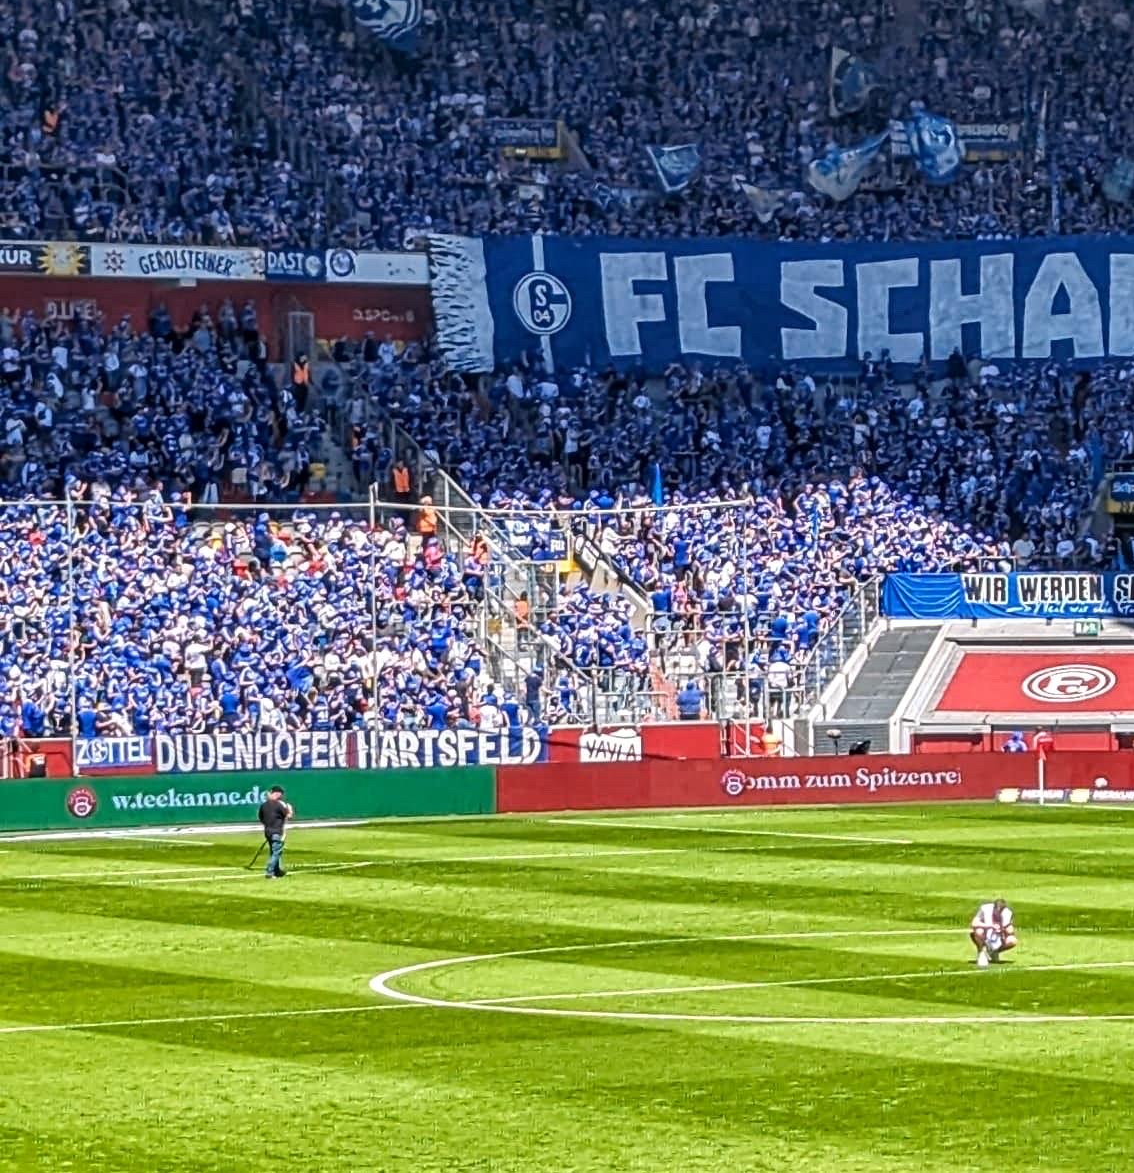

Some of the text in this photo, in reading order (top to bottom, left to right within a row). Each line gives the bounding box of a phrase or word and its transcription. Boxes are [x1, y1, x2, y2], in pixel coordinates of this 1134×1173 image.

[599, 251, 743, 358] FC
[962, 575, 1007, 603] WIR
[1018, 575, 1103, 603] WERDEN
[155, 730, 347, 772] DUDENHOFEN
[806, 773, 851, 788] zum
